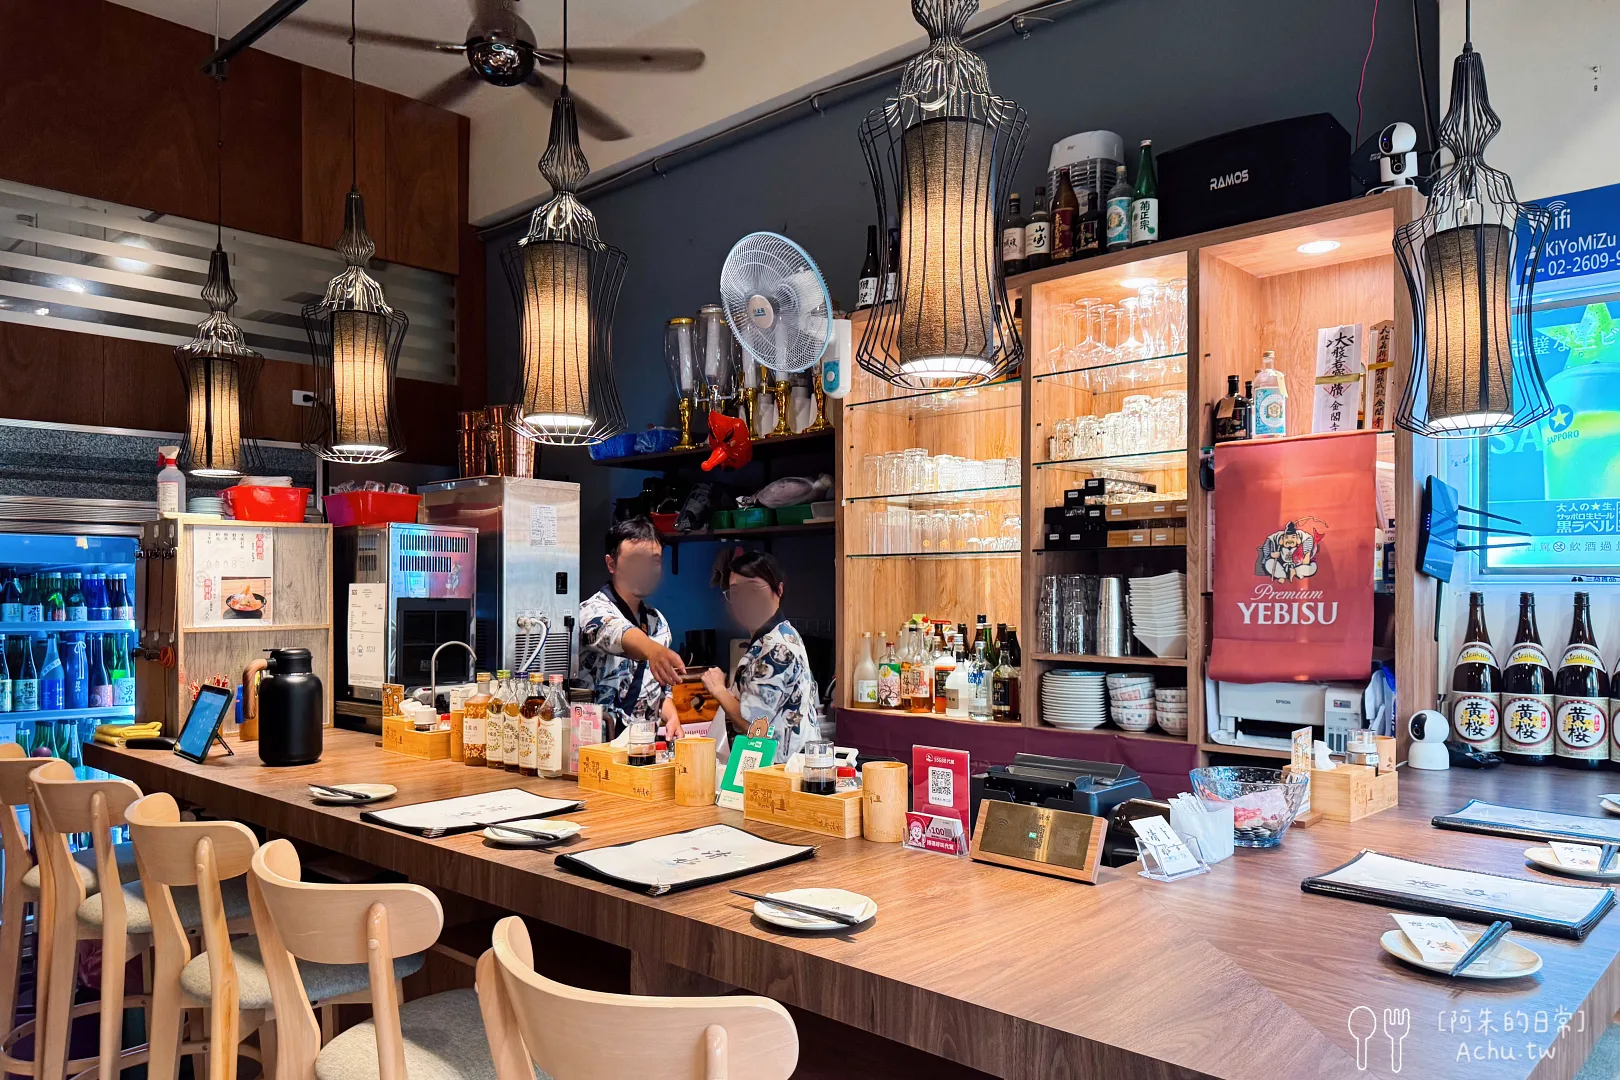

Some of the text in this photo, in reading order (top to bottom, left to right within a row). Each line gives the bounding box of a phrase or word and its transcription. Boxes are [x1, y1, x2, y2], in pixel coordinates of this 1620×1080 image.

[1209, 169, 1249, 191] RAMOS
[1139, 200, 1151, 231] 菊正宗
[1545, 232, 1617, 258] KiYoMiZu
[1546, 429, 1580, 446] SAPPORO
[1556, 512, 1615, 520] サッポロ生ビール
[1556, 520, 1615, 533] 黒ラベル
[1250, 583, 1323, 601] Premium
[1237, 602, 1338, 625] YEBISU
